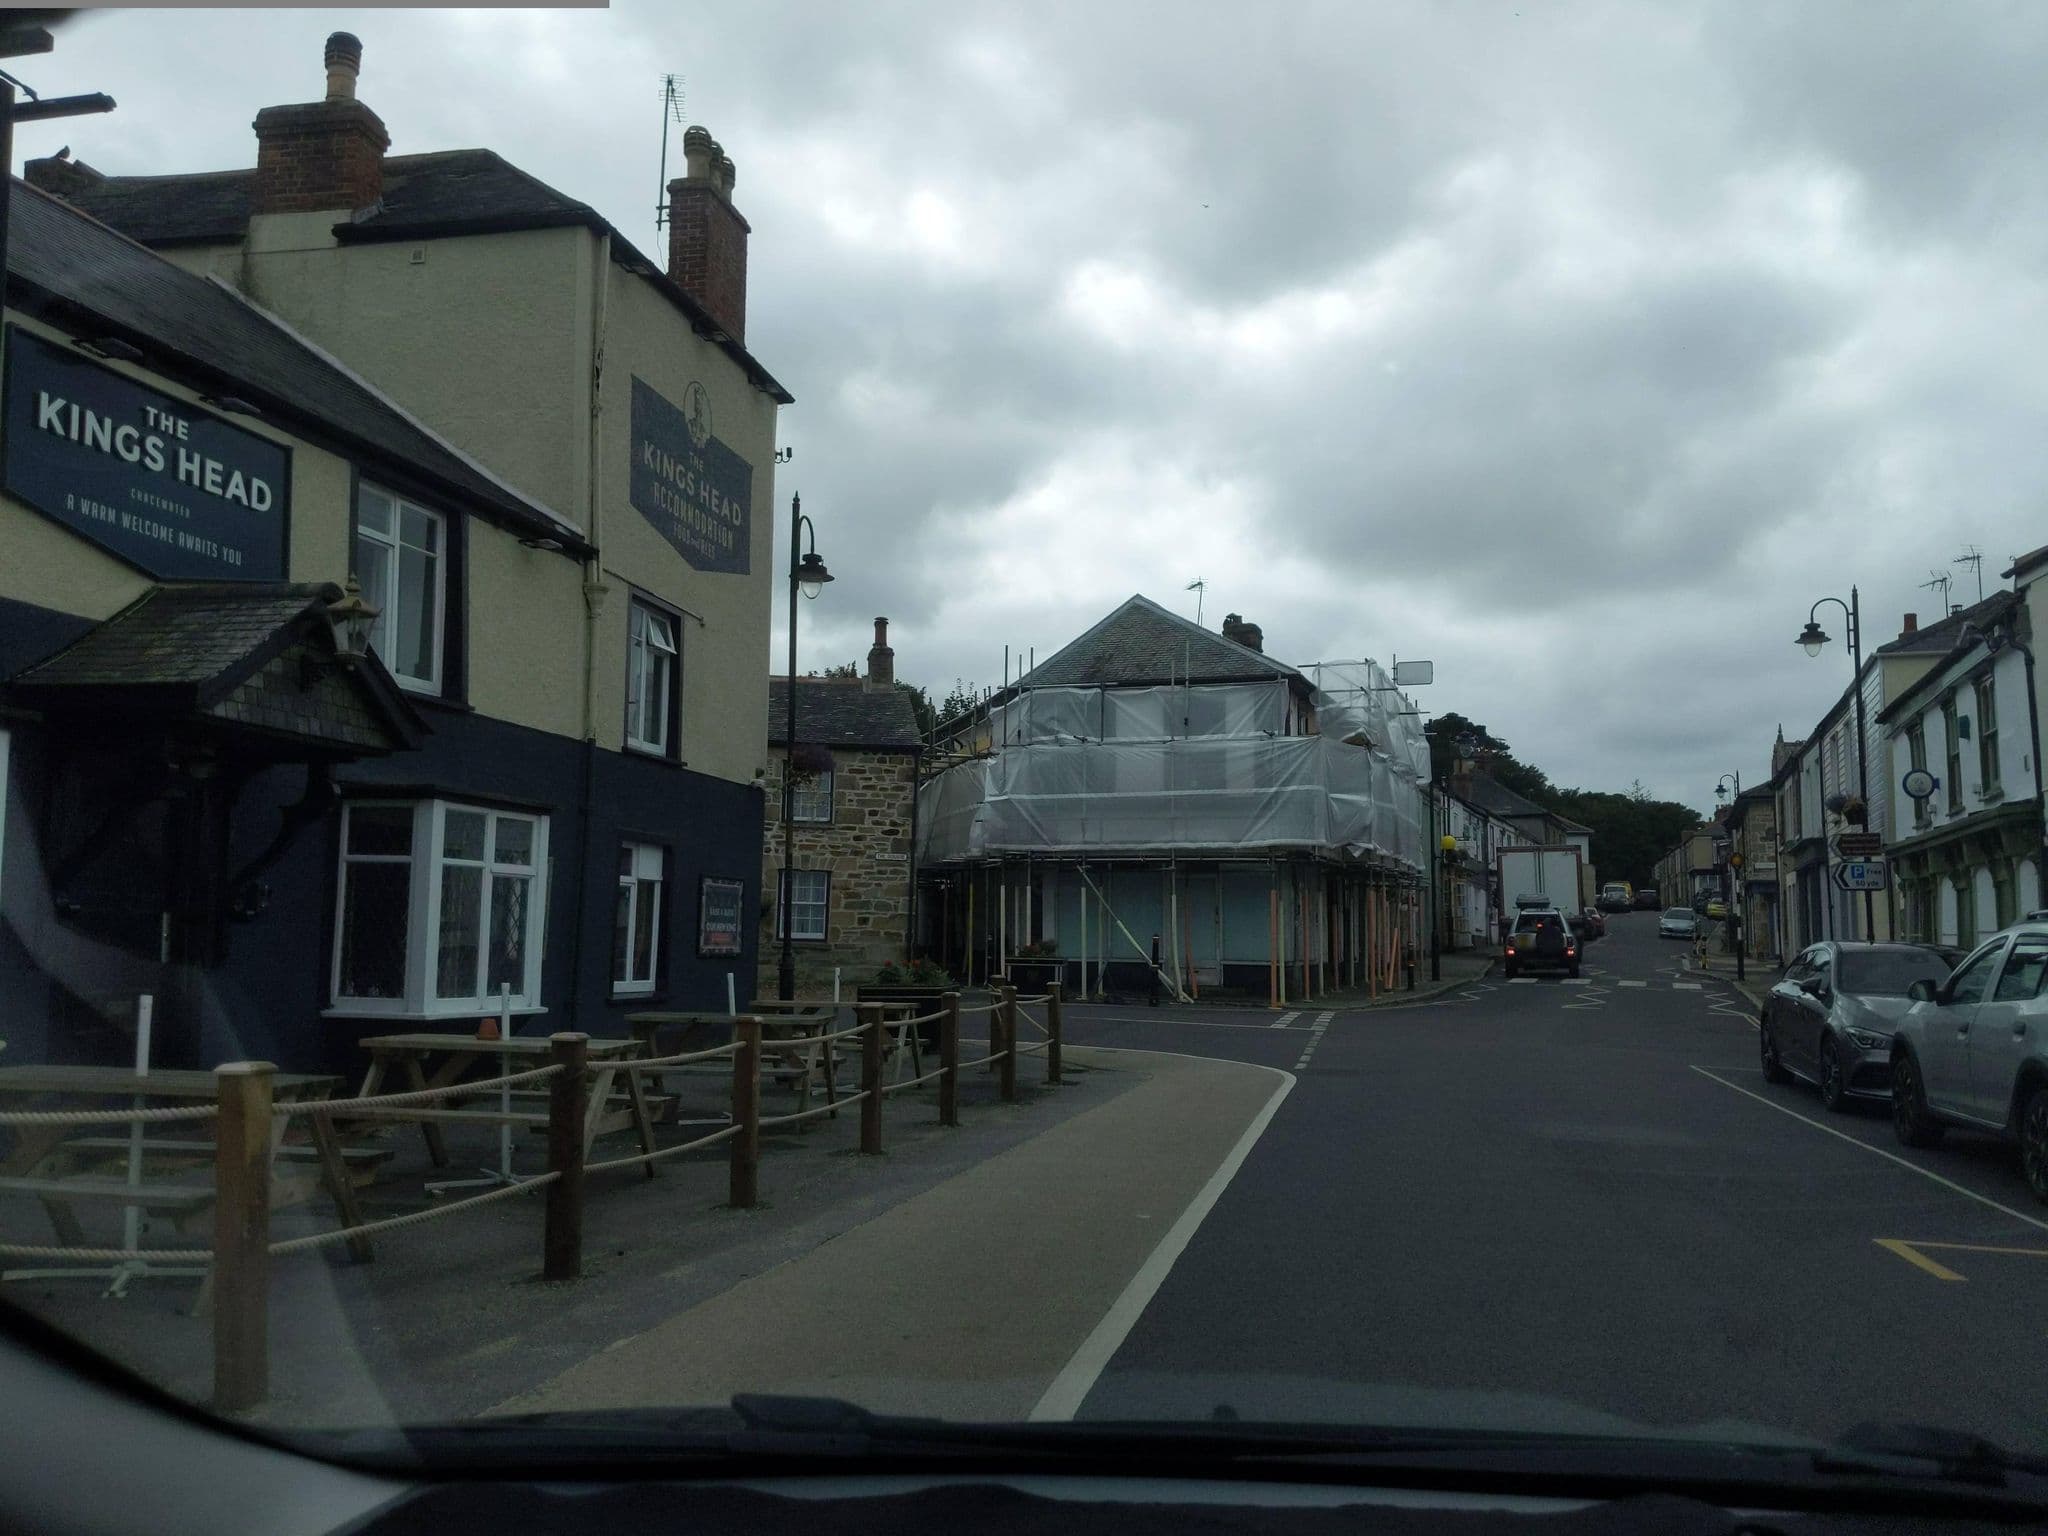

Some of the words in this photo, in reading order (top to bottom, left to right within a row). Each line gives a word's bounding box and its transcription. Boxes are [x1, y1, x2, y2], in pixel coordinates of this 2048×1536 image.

[38, 391, 165, 473] KINGS
[178, 447, 272, 512] HEAD
[145, 405, 189, 440] THE
[643, 440, 695, 497] KINGS
[700, 480, 742, 526] HEAD
[689, 451, 704, 472] THE
[66, 494, 75, 510] A
[81, 498, 116, 524] WARM
[122, 511, 174, 543] WELCOME
[179, 532, 218, 558] AWAITS
[222, 544, 242, 566] YOU
[653, 482, 733, 551] ACCOMMODATION
